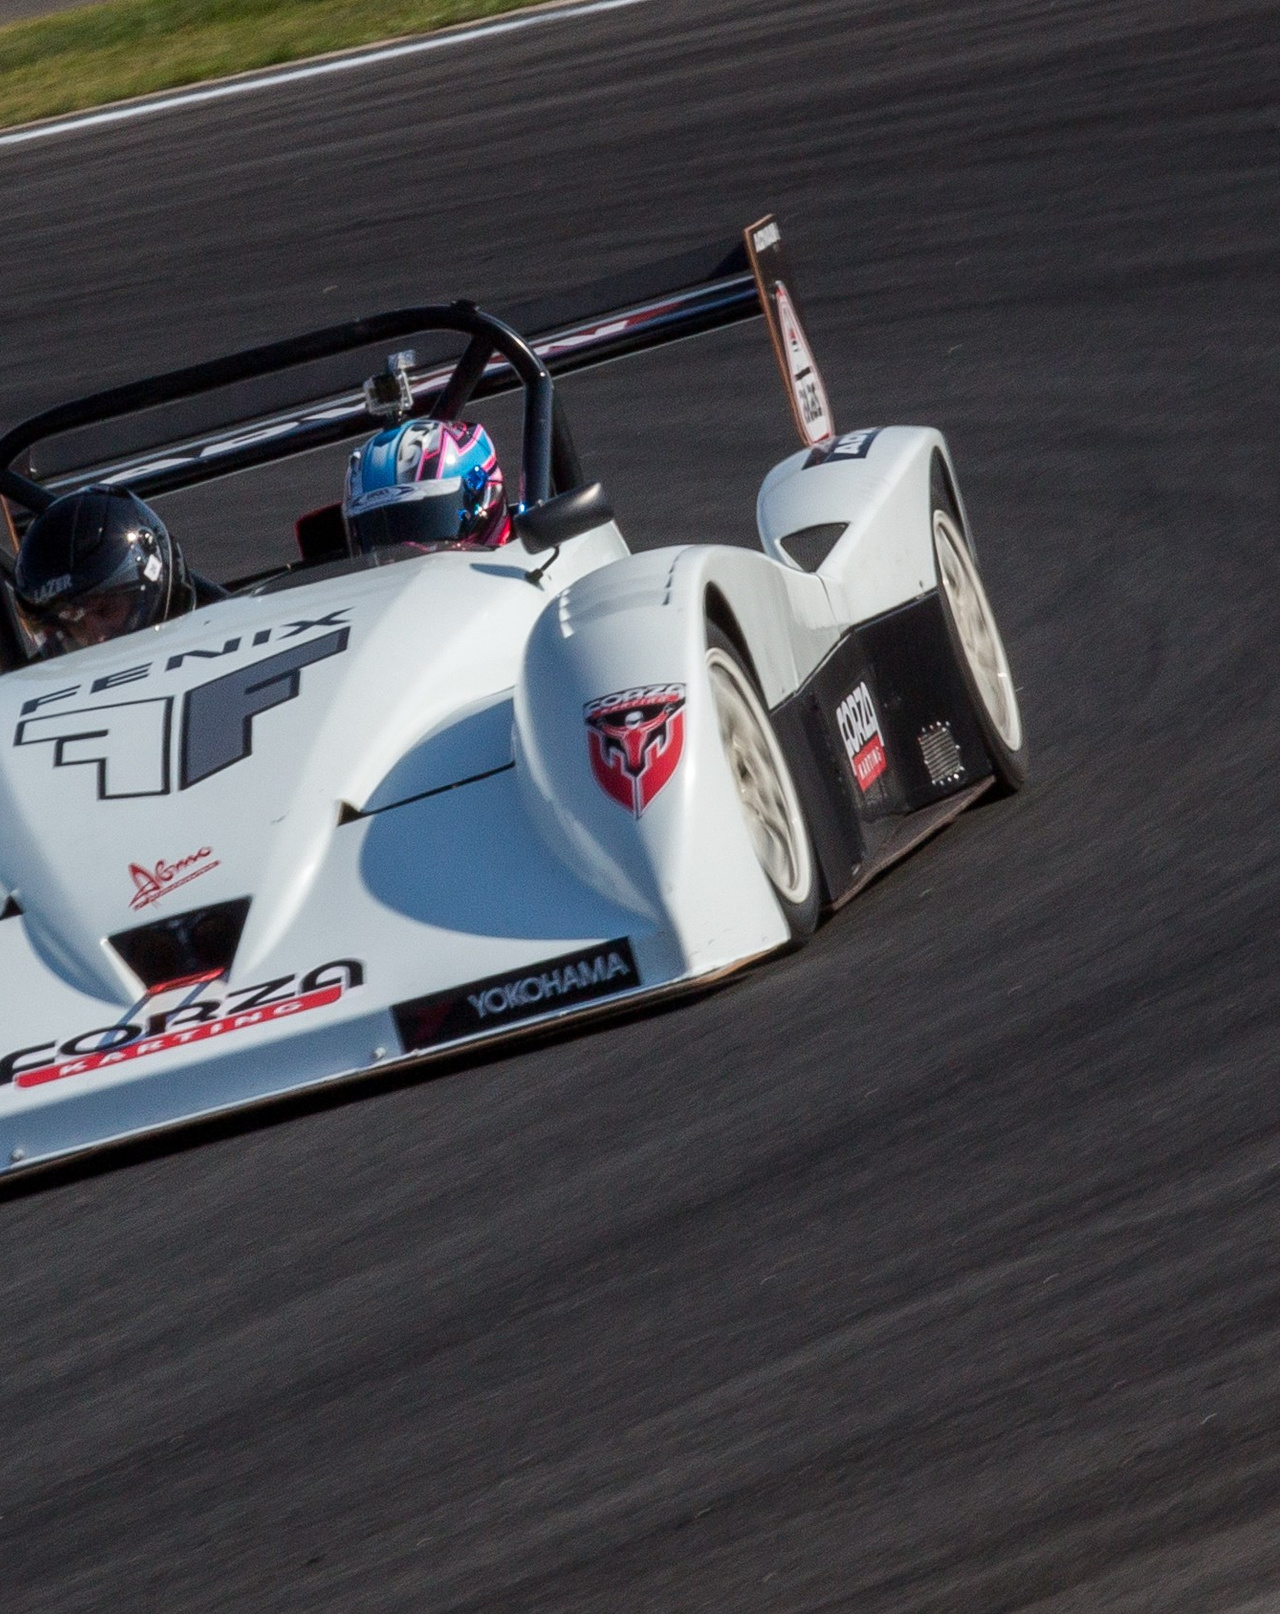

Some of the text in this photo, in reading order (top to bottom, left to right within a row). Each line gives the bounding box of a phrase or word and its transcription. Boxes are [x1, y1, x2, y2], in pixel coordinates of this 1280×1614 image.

[20, 606, 355, 717] FENIX
[467, 951, 631, 1019] YOKOHAMA
[58, 999, 303, 1077] KARTING
